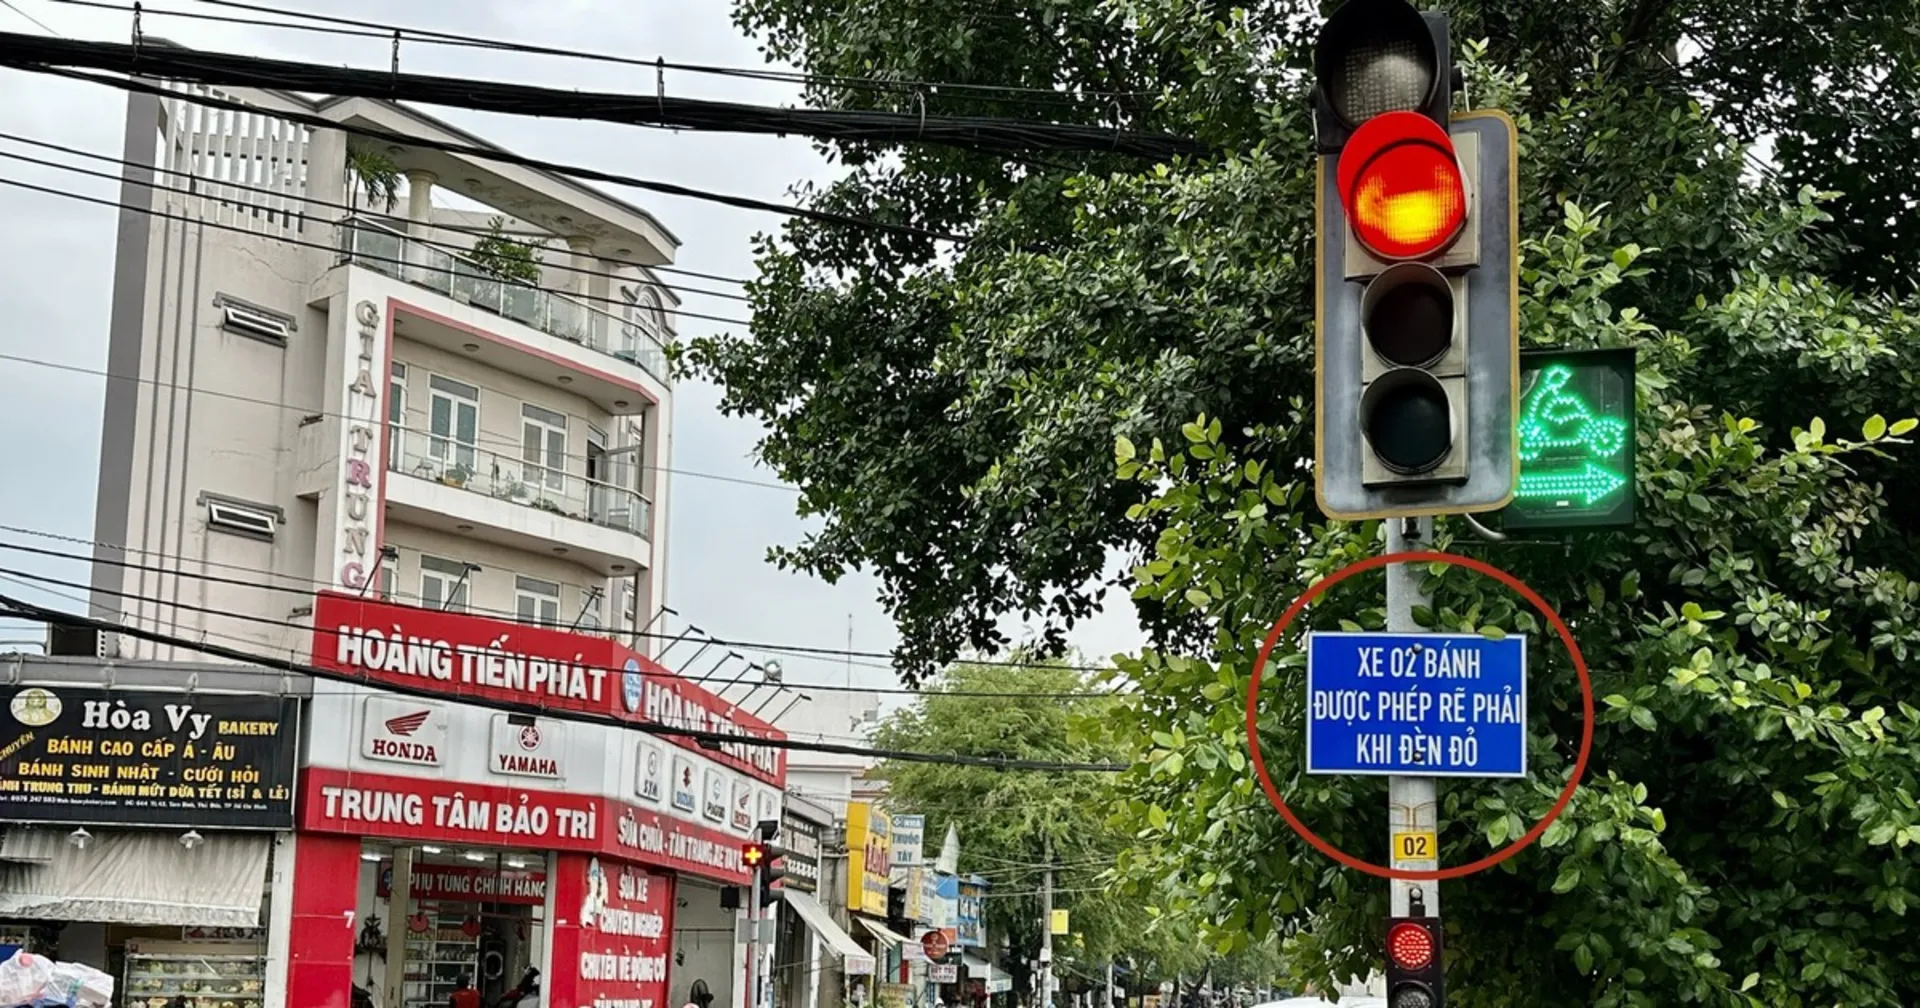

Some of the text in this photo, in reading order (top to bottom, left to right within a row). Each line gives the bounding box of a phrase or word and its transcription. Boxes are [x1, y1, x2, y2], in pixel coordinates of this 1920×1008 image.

[340, 300, 380, 589] GIA TRUNG
[337, 623, 452, 681] HOÀNG
[456, 634, 525, 690] TIẾN
[528, 653, 607, 702] PHÁT
[1357, 640, 1481, 679] XE 02 BÁNH
[82, 700, 279, 739] Hòa Vy BAKERY
[644, 679, 707, 734] HOÀNG
[1313, 684, 1521, 726] ĐƯỢC PHÉP RẼ PHẢI
[47, 735, 93, 755] BÁNH
[100, 741, 134, 756] CAO
[141, 737, 175, 758] CẤP
[183, 740, 195, 759] Á
[212, 742, 235, 760] ÂU
[372, 738, 437, 763] HONDA
[499, 754, 558, 776] YAMAHA
[1356, 726, 1478, 767] KHI ĐÈN ĐỎ
[18, 758, 64, 776] BÁNH
[71, 765, 110, 778] SINH
[117, 763, 160, 784] NHẬT
[183, 765, 224, 783] CƯỚI
[231, 765, 259, 783] HỎI
[22, 781, 64, 794] TRUNG
[67, 782, 92, 794] THU
[101, 781, 136, 796] BÁNH
[198, 783, 223, 799] TẾT
[251, 788, 262, 799] &
[321, 786, 596, 839] TRUNG TÂM BẢO TRÌ
[1403, 837, 1427, 857] 02
[437, 871, 470, 893] TÙNG
